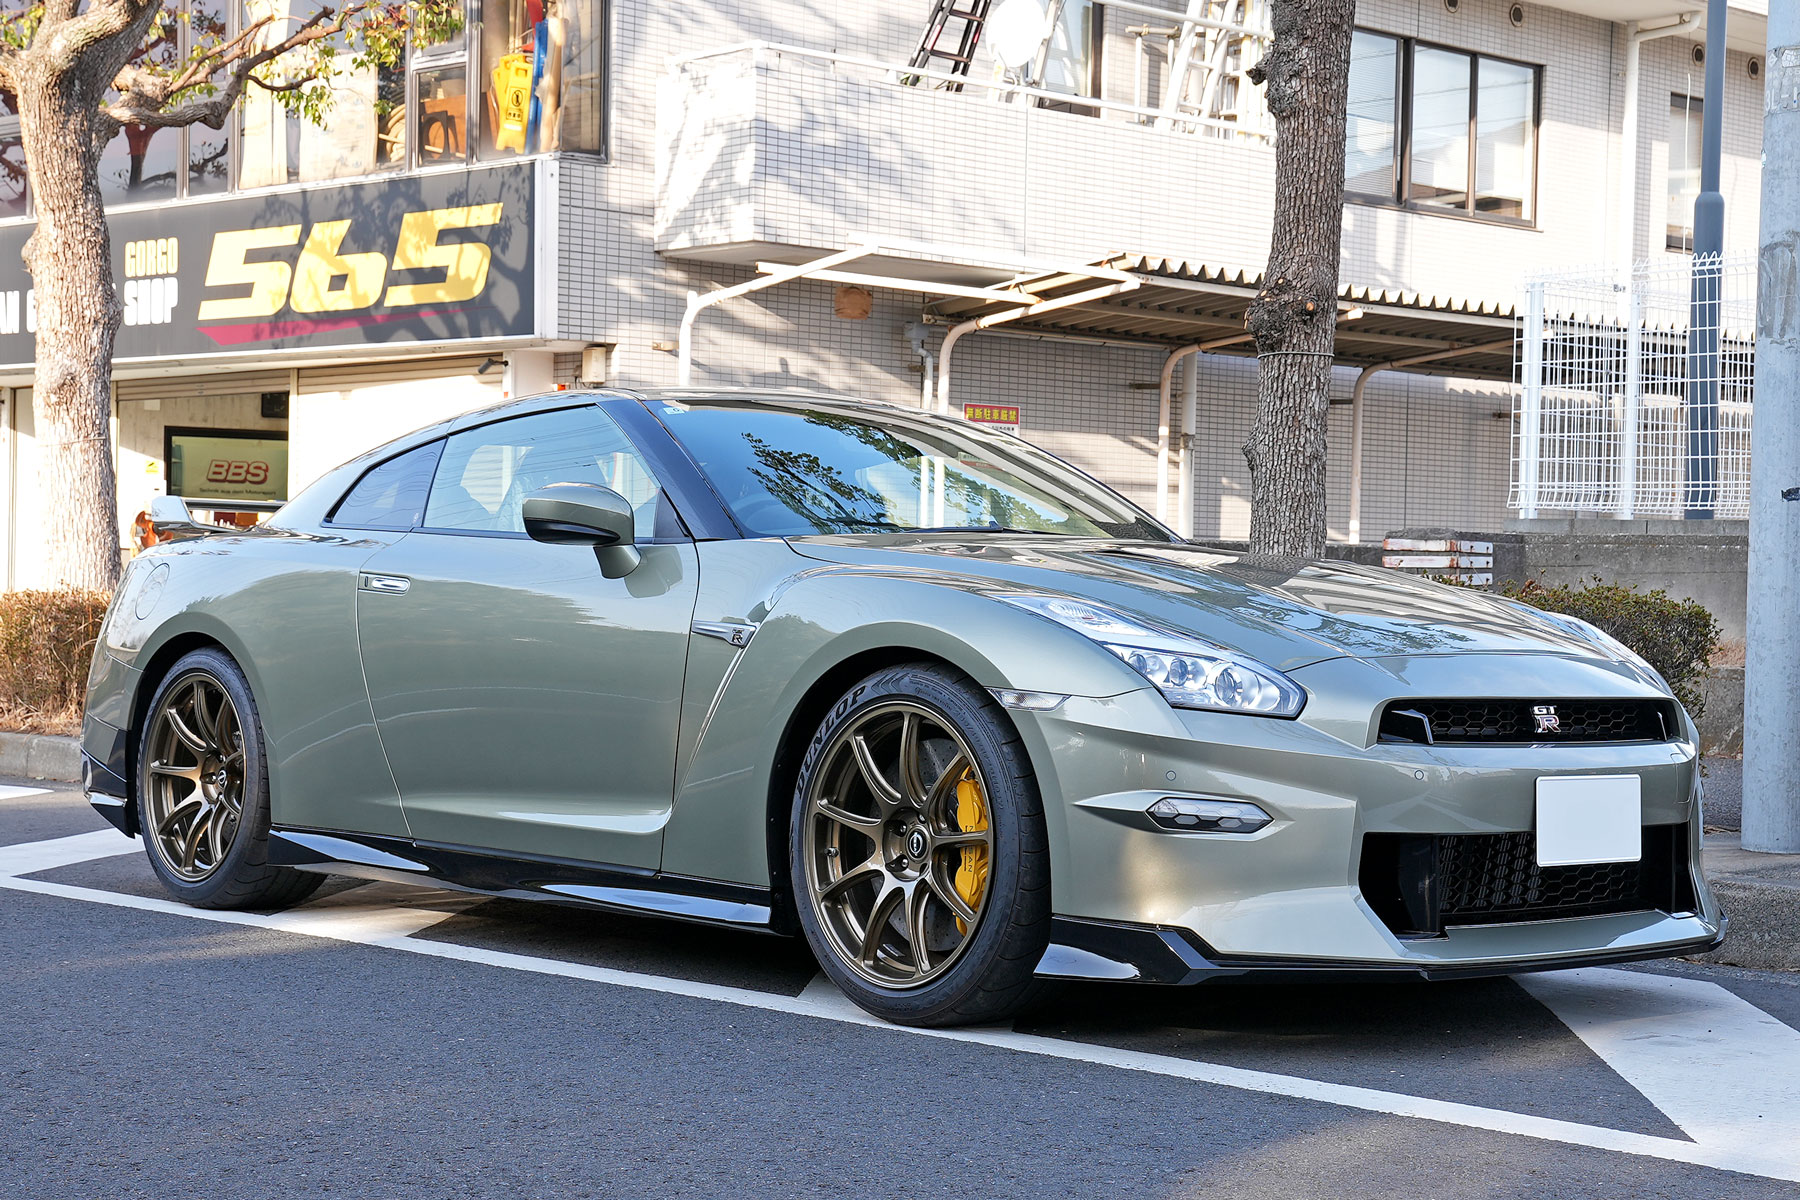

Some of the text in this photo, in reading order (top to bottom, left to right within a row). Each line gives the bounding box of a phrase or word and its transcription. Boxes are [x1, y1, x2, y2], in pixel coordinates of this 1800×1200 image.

[125, 237, 179, 278] GORGO
[197, 202, 504, 321] 565
[124, 277, 179, 327] SHOP
[206, 459, 269, 485] BBS
[796, 684, 867, 798] DUNLOP
